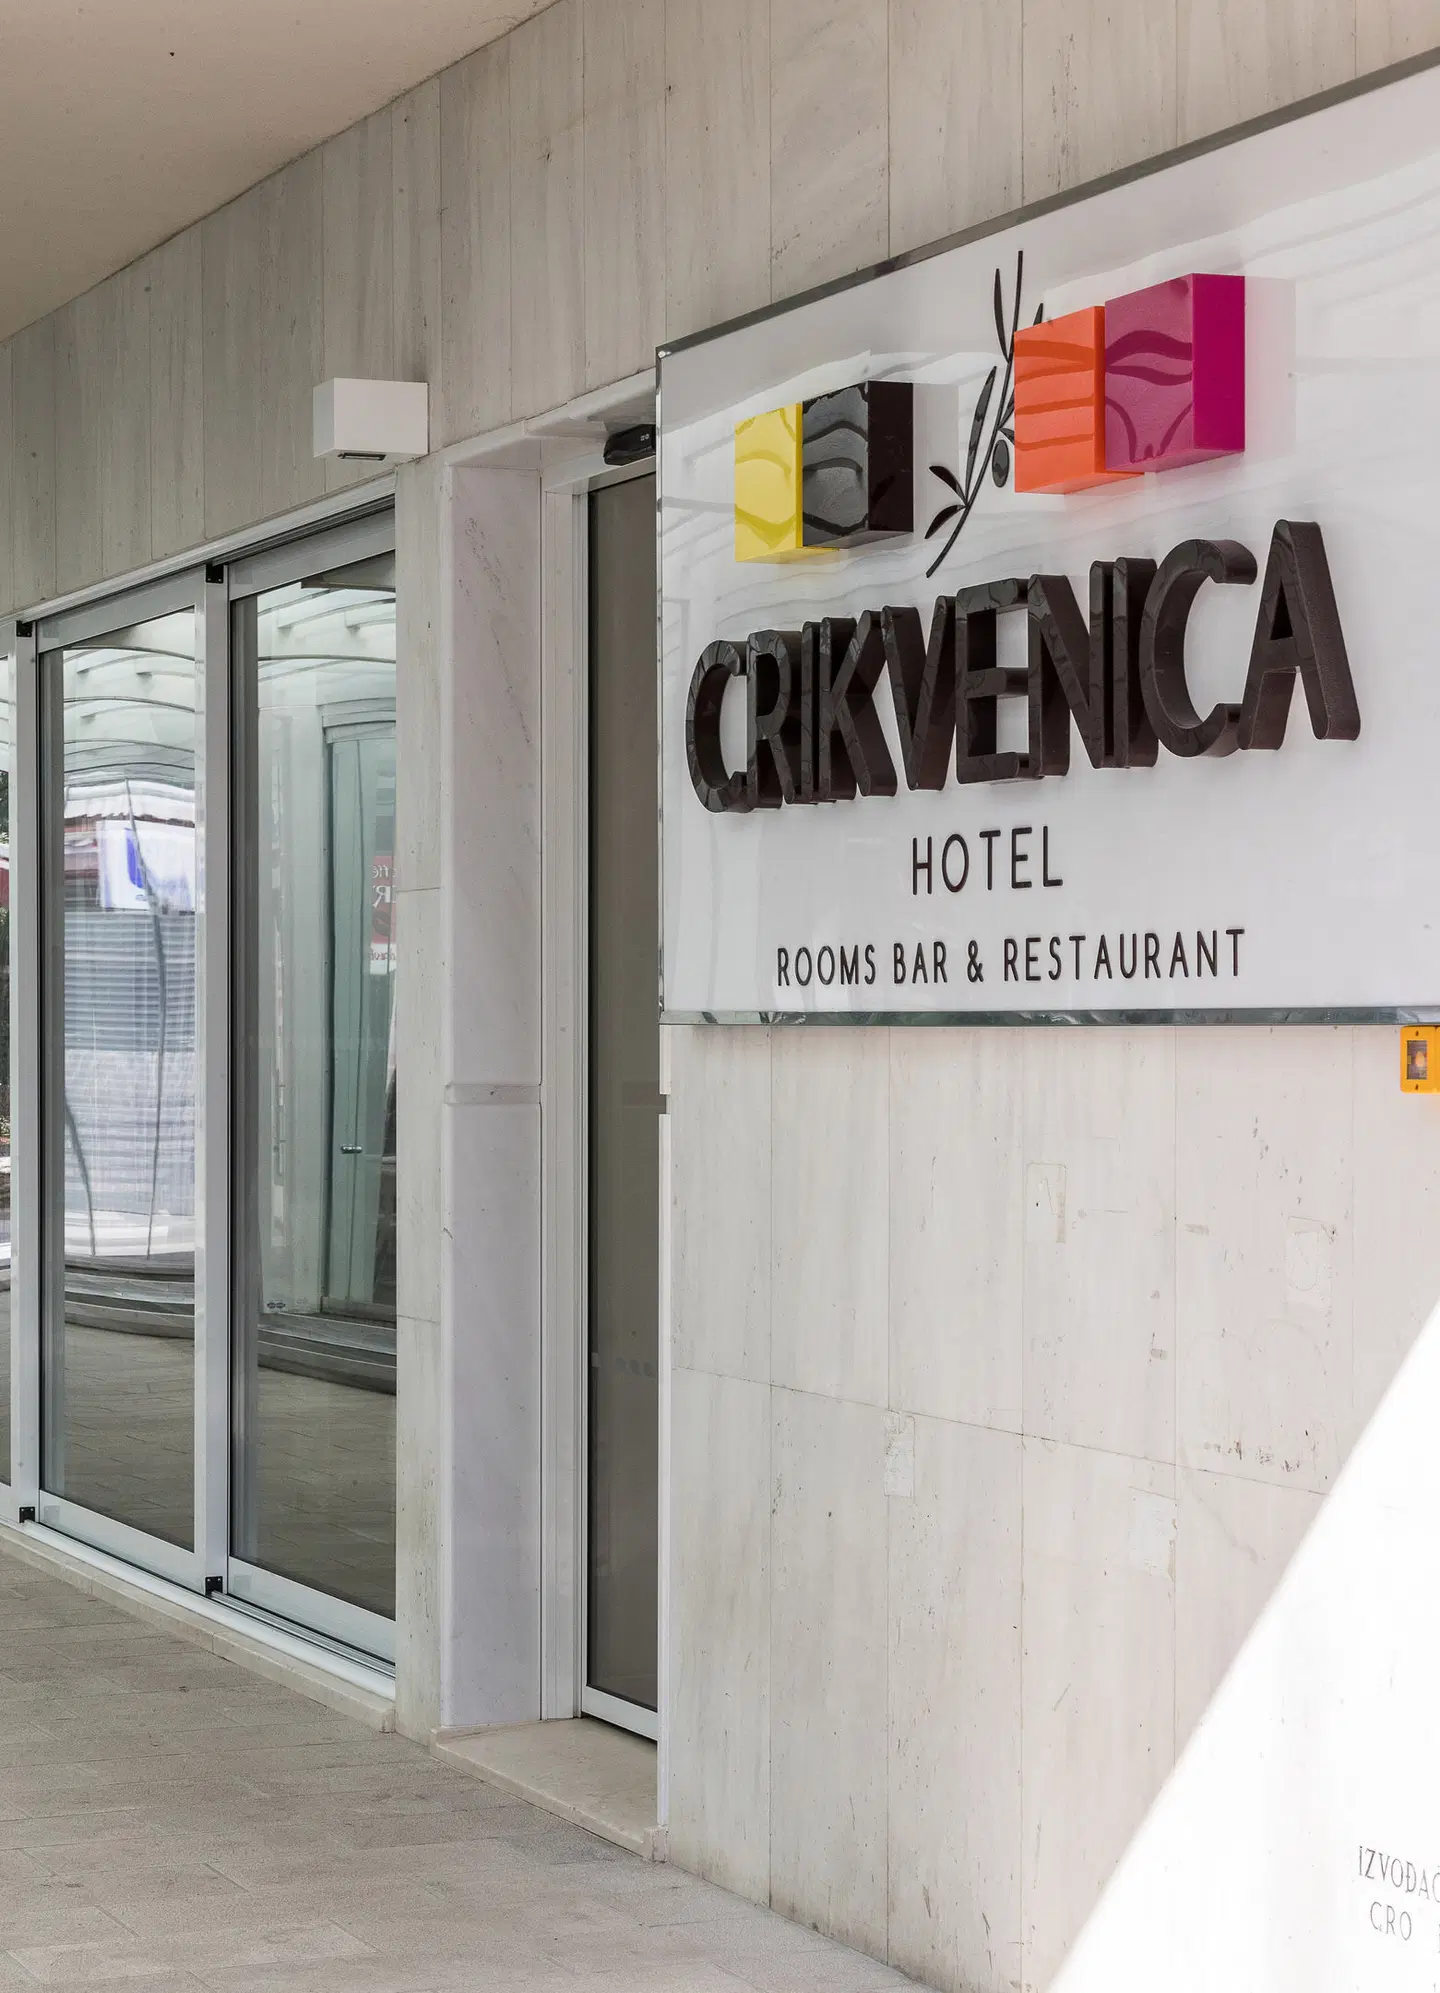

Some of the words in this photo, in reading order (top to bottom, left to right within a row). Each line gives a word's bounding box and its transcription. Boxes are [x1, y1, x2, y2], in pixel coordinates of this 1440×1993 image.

[685, 519, 1361, 813] CRIKVENICA
[912, 825, 1064, 896] HOTEL
[777, 943, 876, 987] ROOMS
[893, 940, 948, 985] BAR
[967, 939, 985, 983] &
[1003, 928, 1245, 982] RESTAURANT
[1369, 1901, 1412, 1942] CRO
